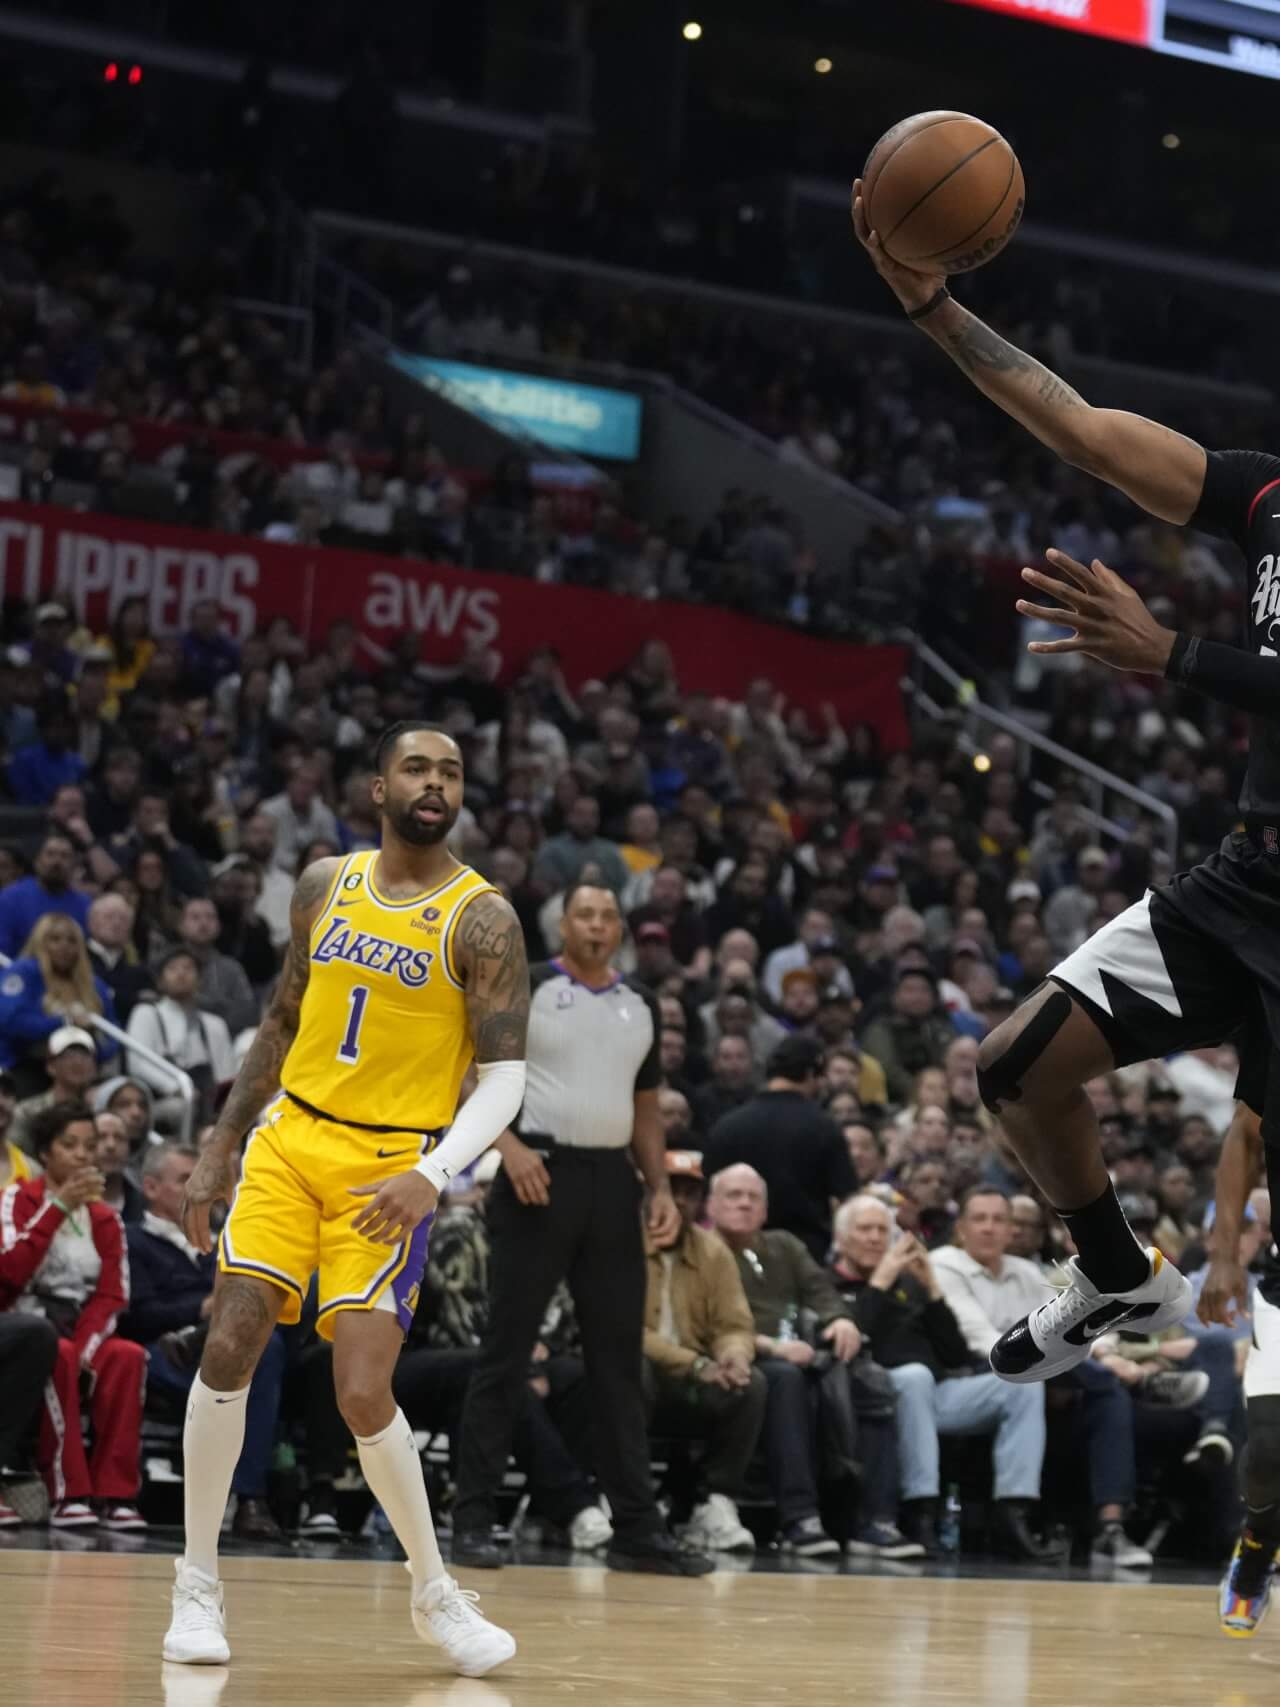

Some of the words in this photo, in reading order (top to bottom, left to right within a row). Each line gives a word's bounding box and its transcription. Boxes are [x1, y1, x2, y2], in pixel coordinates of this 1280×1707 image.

[364, 571, 502, 646] aws
[311, 917, 434, 988] LAKERS
[410, 918, 441, 936] bibigo
[335, 984, 370, 1066] 1
